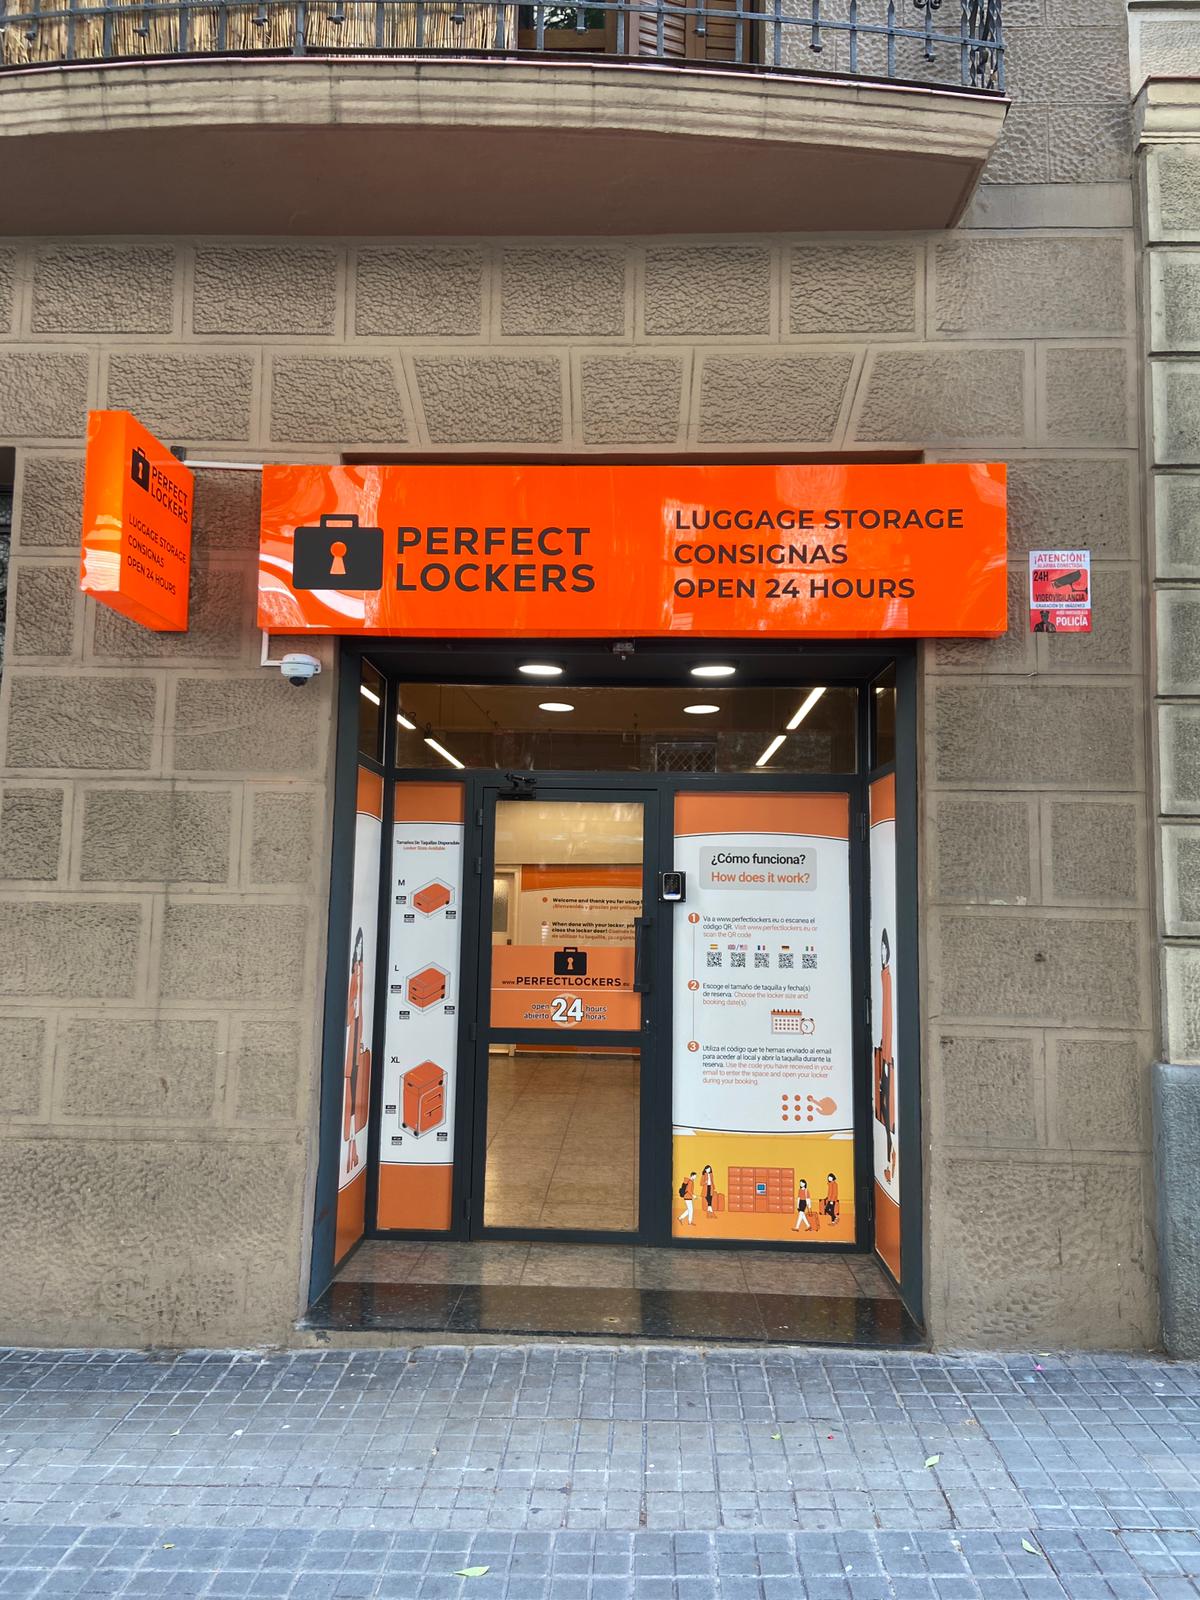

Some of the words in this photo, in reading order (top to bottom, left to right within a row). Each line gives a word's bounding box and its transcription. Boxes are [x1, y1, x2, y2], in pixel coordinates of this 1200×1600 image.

[152, 466, 188, 506] PERFECT
[151, 483, 188, 524] LOCKERS
[675, 509, 815, 530] LUGGAGE
[824, 508, 964, 530] STORAGE
[129, 513, 158, 544] LUGGAGE
[160, 536, 187, 564] STORAGE
[397, 526, 590, 556] PERFECT
[128, 534, 164, 568] CONSIGNAS
[674, 543, 849, 565] CONSIGNAS
[1034, 553, 1086, 564] ¡ATENCIÓN!
[127, 555, 146, 575] OPEN
[146, 568, 154, 581] 24
[155, 575, 176, 596] HOURS
[396, 563, 595, 593] LOCKERS
[1033, 571, 1049, 582] 24H
[673, 578, 756, 599] OPEN
[765, 578, 800, 599] 24
[810, 578, 916, 599] HOURS
[1035, 593, 1086, 602] VIDEOVIGILANCIA
[1055, 615, 1088, 627] POLICÍA
[711, 852, 751, 866] ¿Cómo
[752, 853, 807, 865] funciona?
[711, 871, 736, 882] How
[738, 871, 766, 883] does
[767, 872, 775, 883] it
[777, 872, 810, 884] work?
[523, 1012, 550, 1020] abierto
[585, 1012, 607, 1020] horas
[532, 1003, 550, 1011] open
[551, 997, 585, 1022] 24
[585, 1005, 607, 1013] hours
[390, 1056, 400, 1064] XL
